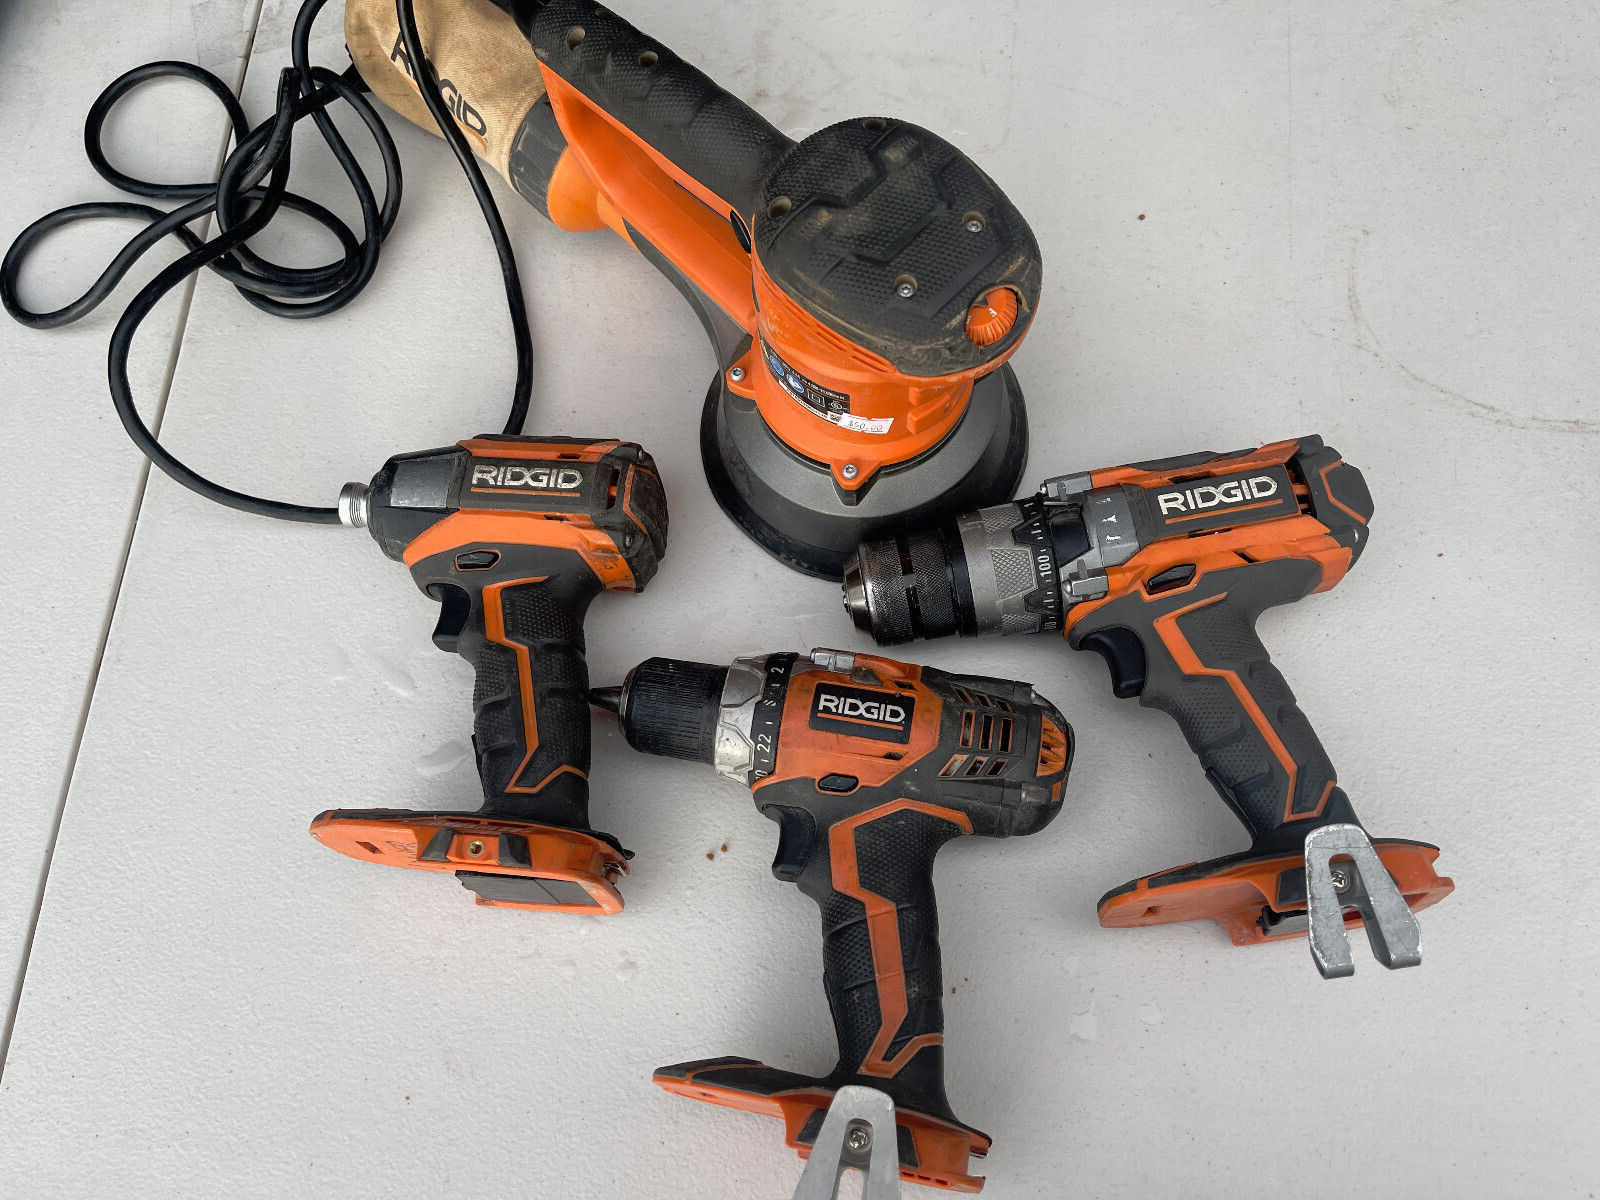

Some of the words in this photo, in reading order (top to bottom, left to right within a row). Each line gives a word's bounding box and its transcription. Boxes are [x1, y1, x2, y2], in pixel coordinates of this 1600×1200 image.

[471, 464, 583, 489] RIDGID
[1157, 476, 1278, 515] RIDGID
[1037, 555, 1052, 578] 100
[818, 693, 906, 724] RIDGID
[757, 733, 772, 754] 22
